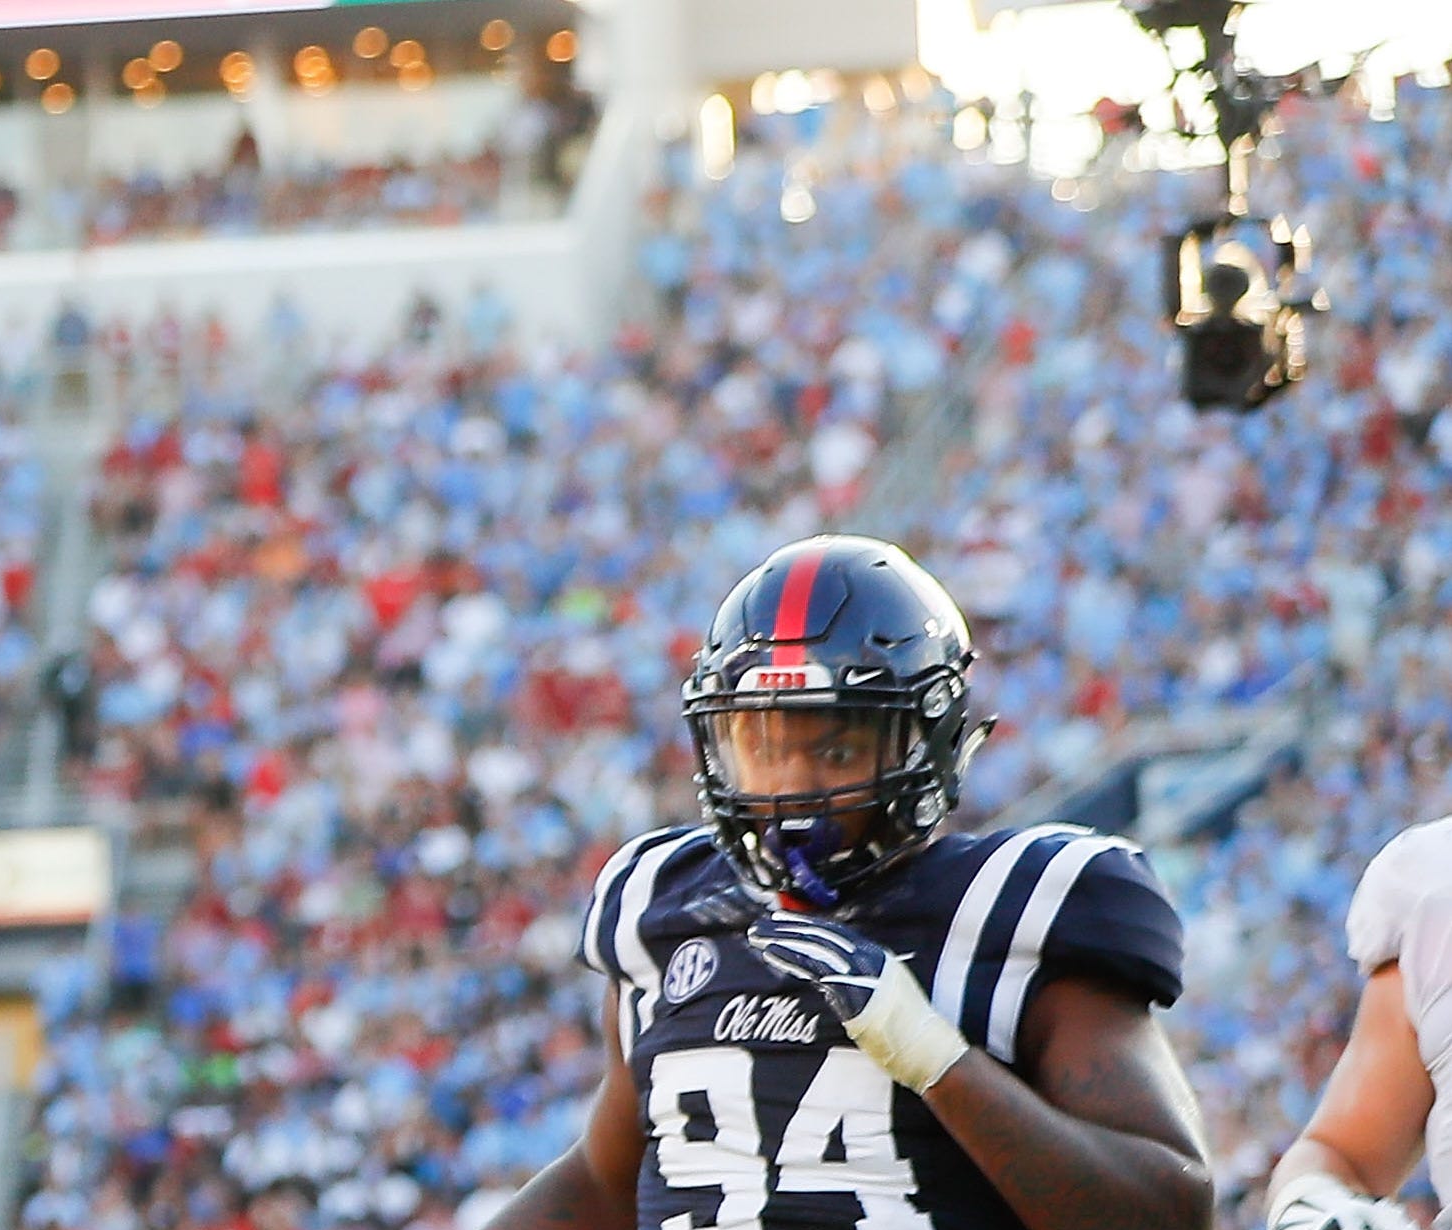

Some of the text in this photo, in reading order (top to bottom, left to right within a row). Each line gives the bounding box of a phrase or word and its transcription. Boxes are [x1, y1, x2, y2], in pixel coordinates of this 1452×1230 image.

[665, 939, 718, 1001] SEC
[713, 993, 820, 1045] Ole Miss
